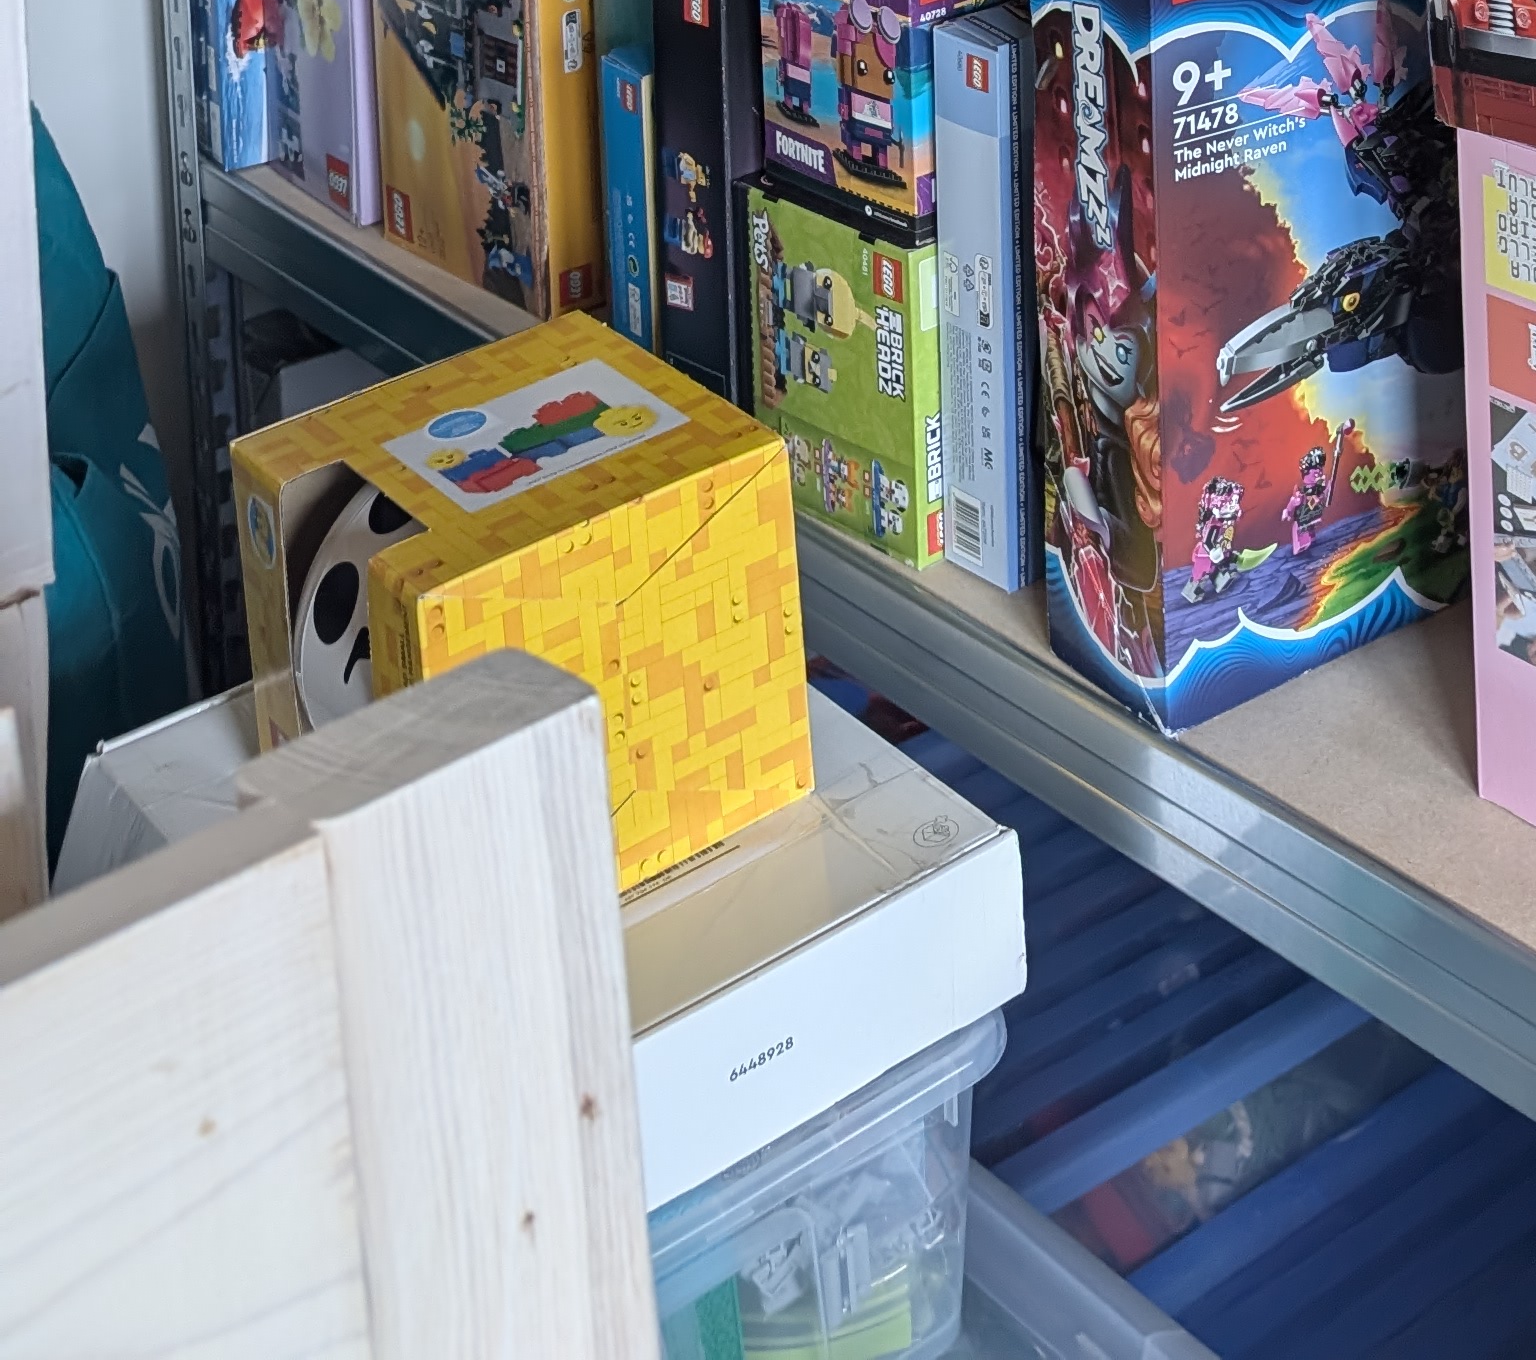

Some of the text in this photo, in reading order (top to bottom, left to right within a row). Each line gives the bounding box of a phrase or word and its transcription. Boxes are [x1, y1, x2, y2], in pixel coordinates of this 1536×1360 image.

[919, 7, 948, 24] 40728
[970, 56, 985, 91] LEGO
[1171, 59, 1232, 106] 9+
[1172, 103, 1239, 140] 71478
[1173, 116, 1307, 165] The Never Witch's
[775, 129, 827, 175] FORTNITE
[1173, 139, 1288, 183] Midnight Raven
[752, 209, 770, 274] Pets
[568, 271, 582, 299] LEGO
[879, 257, 894, 298] LEGO
[892, 327, 906, 402] BRICK
[926, 411, 942, 478] BRICK
[729, 1036, 795, 1083] 6448928
